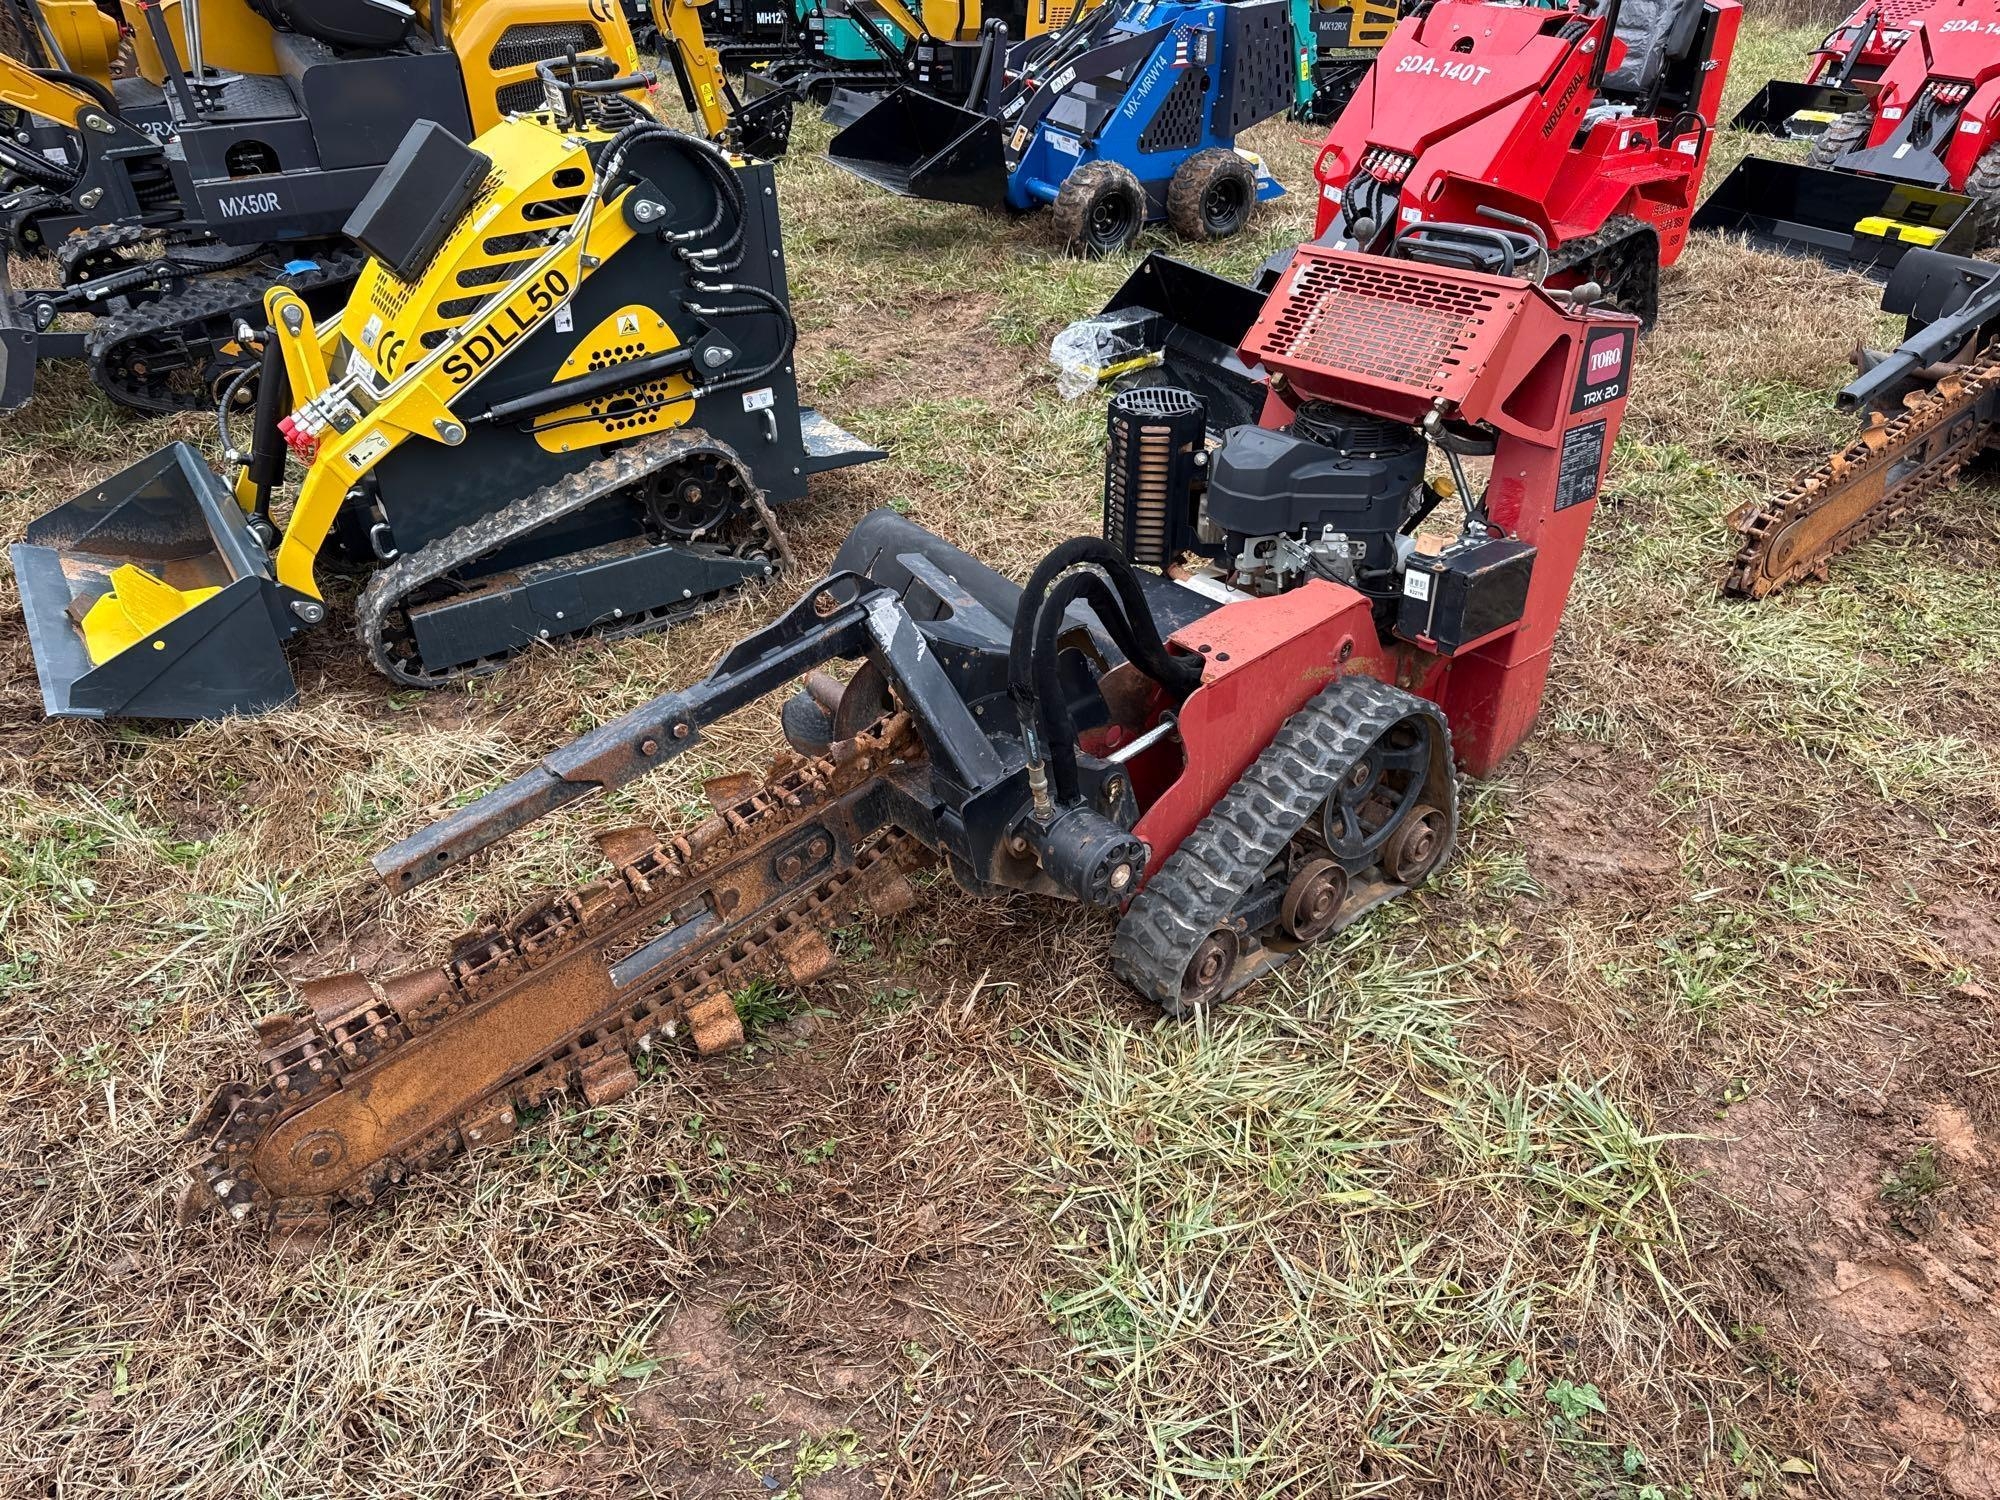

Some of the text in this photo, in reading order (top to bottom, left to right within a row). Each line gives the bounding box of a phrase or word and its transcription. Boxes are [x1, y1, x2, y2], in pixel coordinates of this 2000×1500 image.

[756, 12, 785, 24] MH12
[1319, 22, 1348, 31] MX12RX
[1395, 55, 1491, 86] SDA-140T
[1123, 55, 1168, 119] MX-MRW14
[1541, 72, 1586, 141] INDUSTRIAL
[218, 192, 282, 218] MX50R
[442, 269, 570, 384] SDLL50
[1591, 348, 1621, 371] TORO
